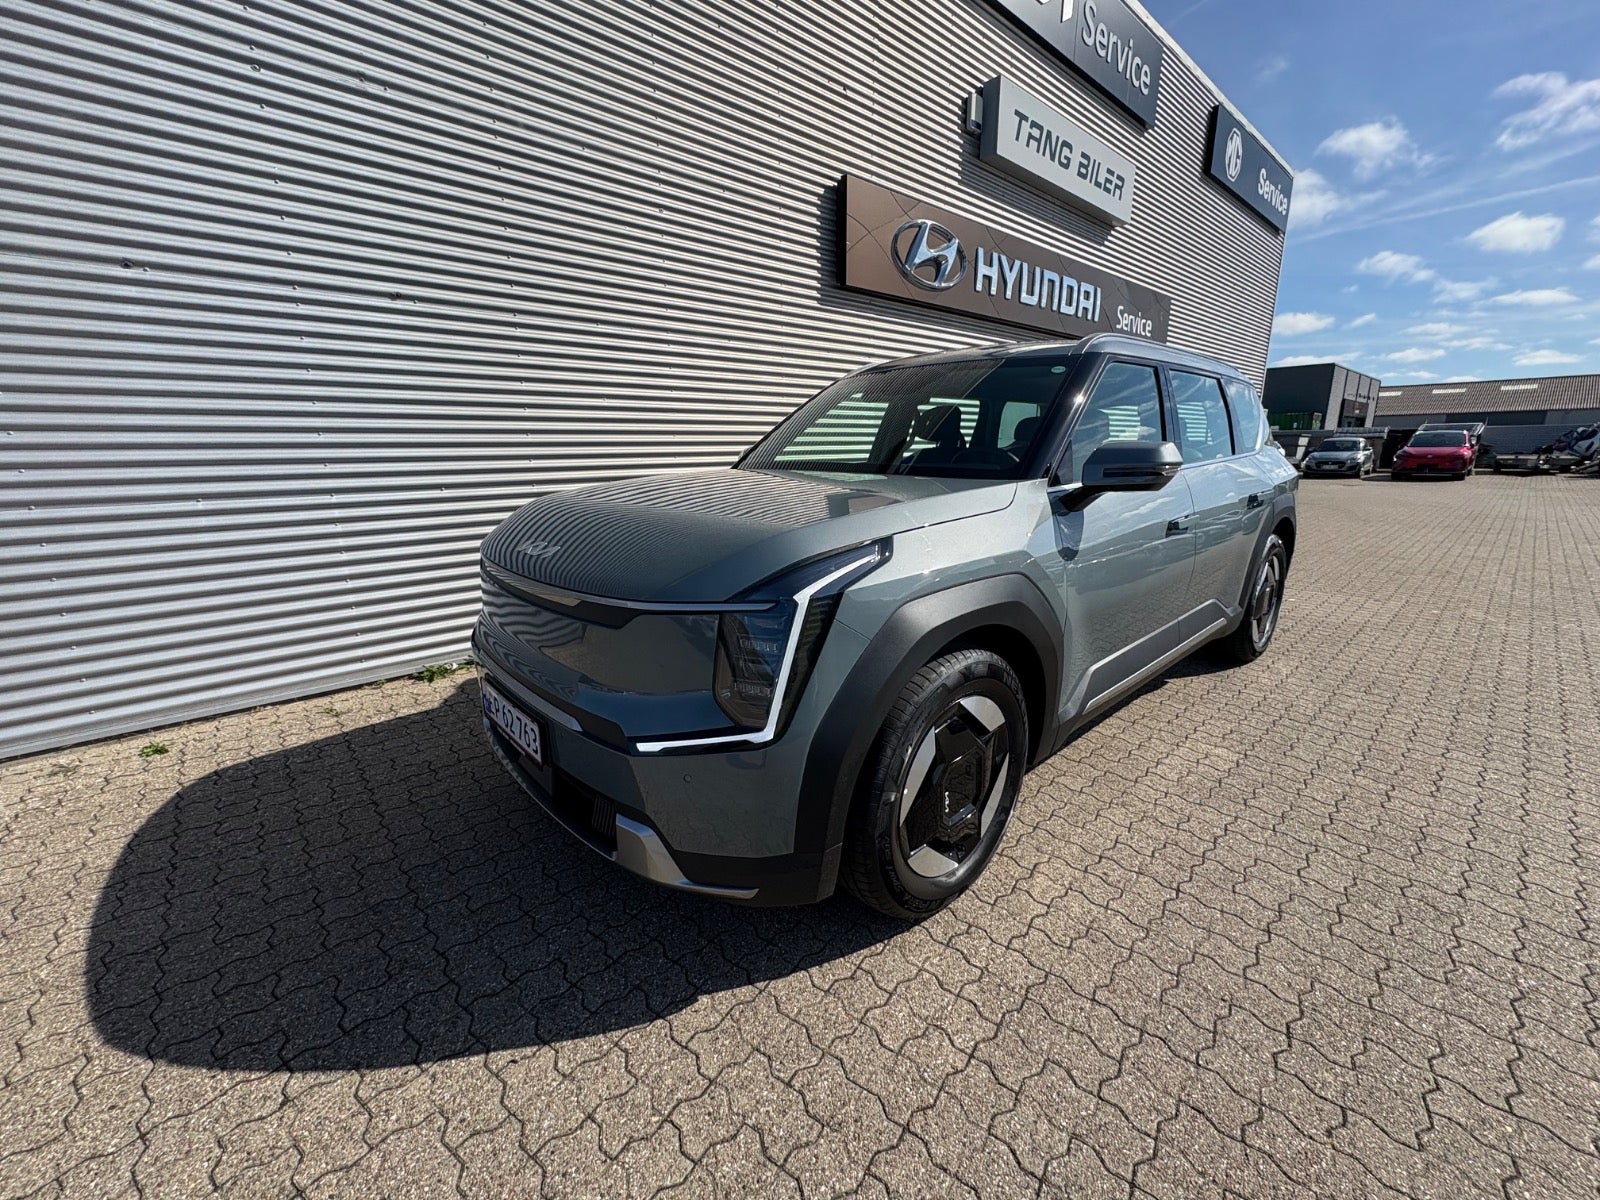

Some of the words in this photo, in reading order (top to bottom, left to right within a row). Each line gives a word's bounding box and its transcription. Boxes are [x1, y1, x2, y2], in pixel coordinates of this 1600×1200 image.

[1081, 0, 1151, 96] Service
[1013, 108, 1074, 170] TANG
[1076, 150, 1126, 201] BILER
[1258, 167, 1288, 216] Service
[974, 246, 1101, 323] HYUNDAI
[1116, 305, 1153, 337] Service
